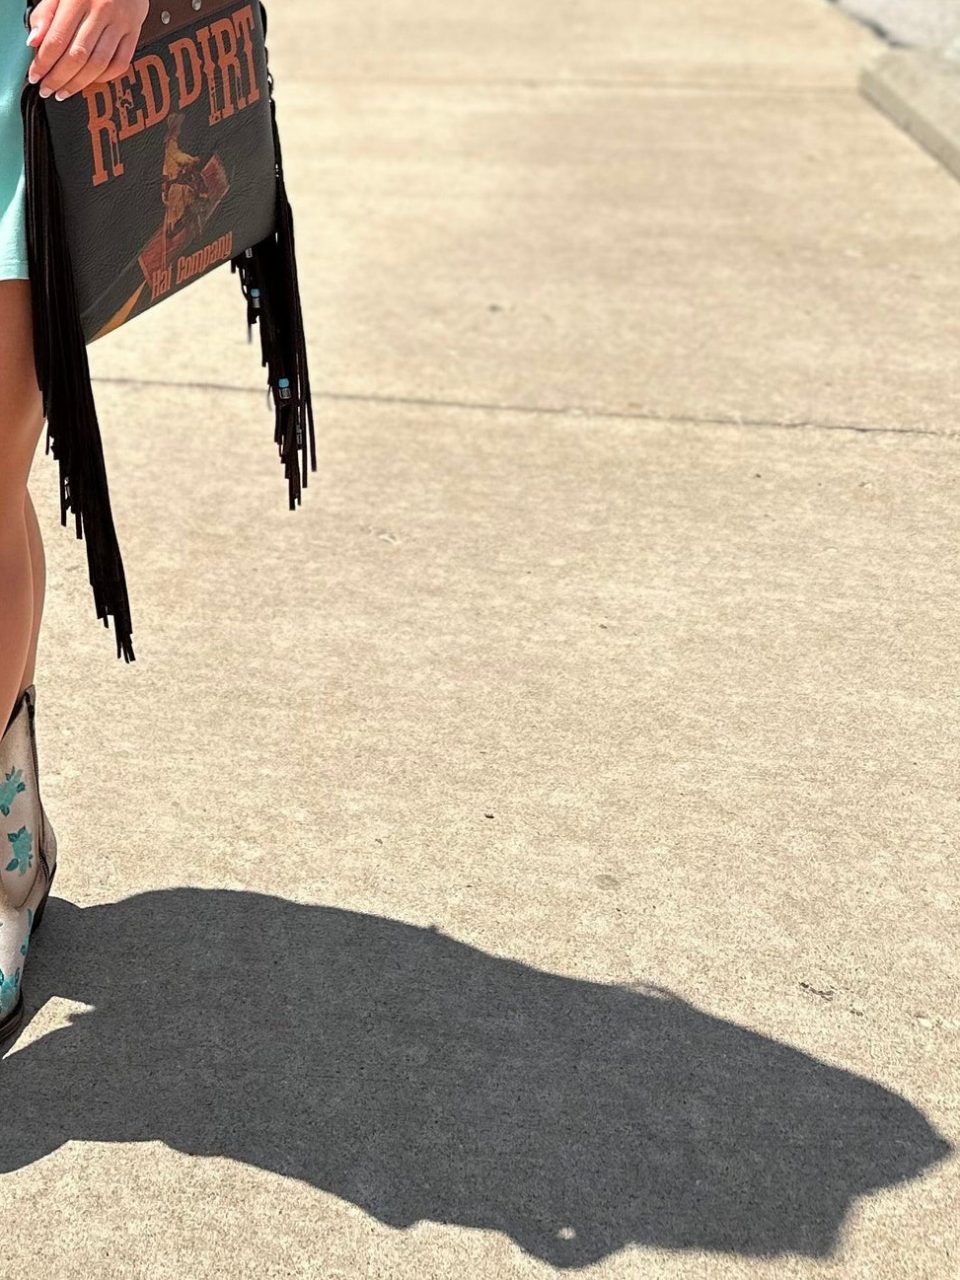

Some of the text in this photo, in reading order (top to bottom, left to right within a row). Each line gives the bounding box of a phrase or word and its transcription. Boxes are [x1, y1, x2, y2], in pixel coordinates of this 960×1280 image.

[82, 4, 259, 186] RED DIRT
[151, 231, 232, 303] Hat Company
